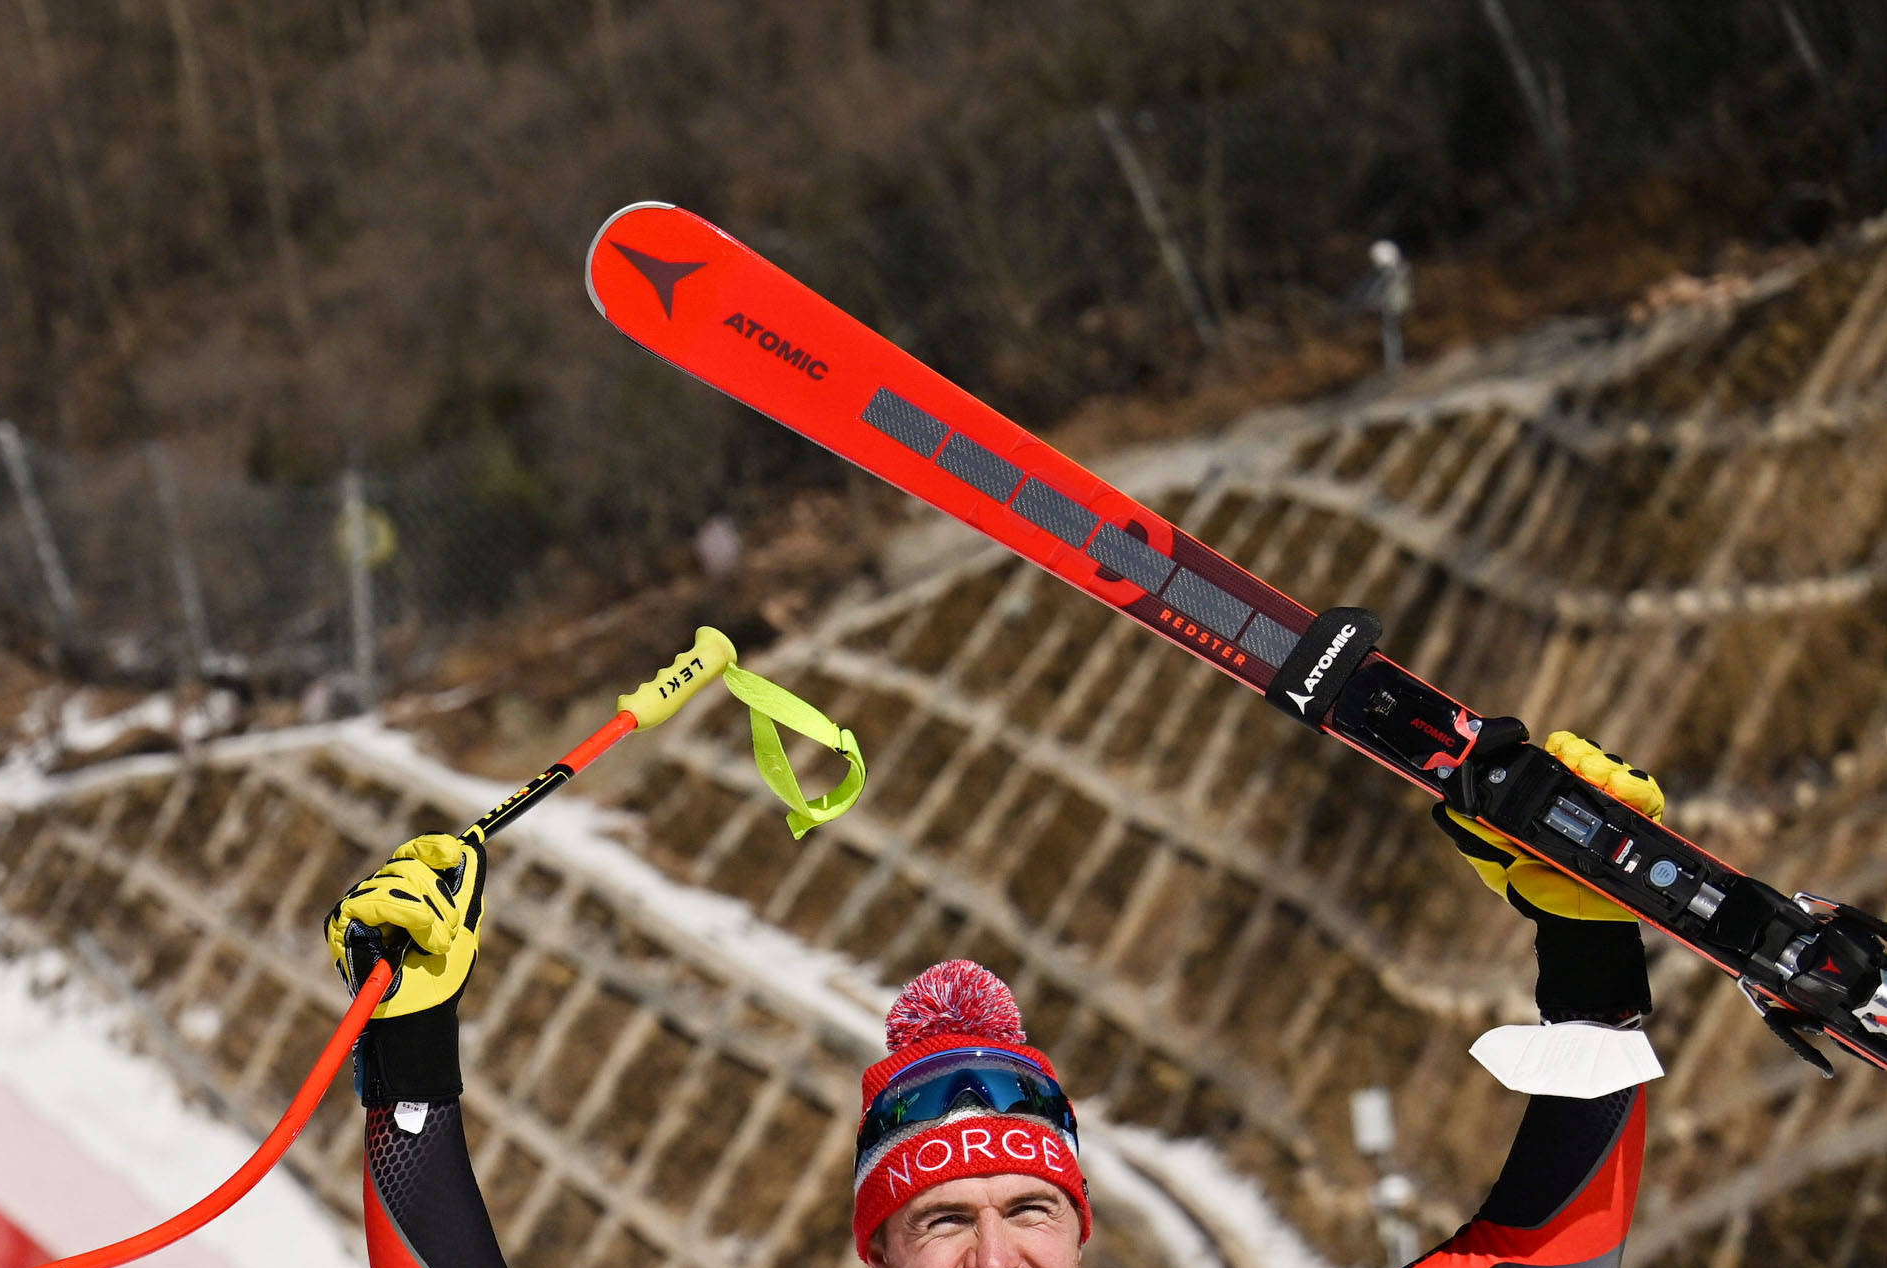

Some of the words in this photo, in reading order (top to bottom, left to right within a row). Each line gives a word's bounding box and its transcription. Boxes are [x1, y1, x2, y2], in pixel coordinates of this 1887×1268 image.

[723, 311, 829, 382] ATOMIC
[1159, 608, 1247, 668] REDSTER
[1303, 623, 1358, 694] ATOMIC
[659, 657, 704, 699] LEKI
[1410, 717, 1456, 748] ATOMIC
[886, 1127, 1065, 1199] NORGE
